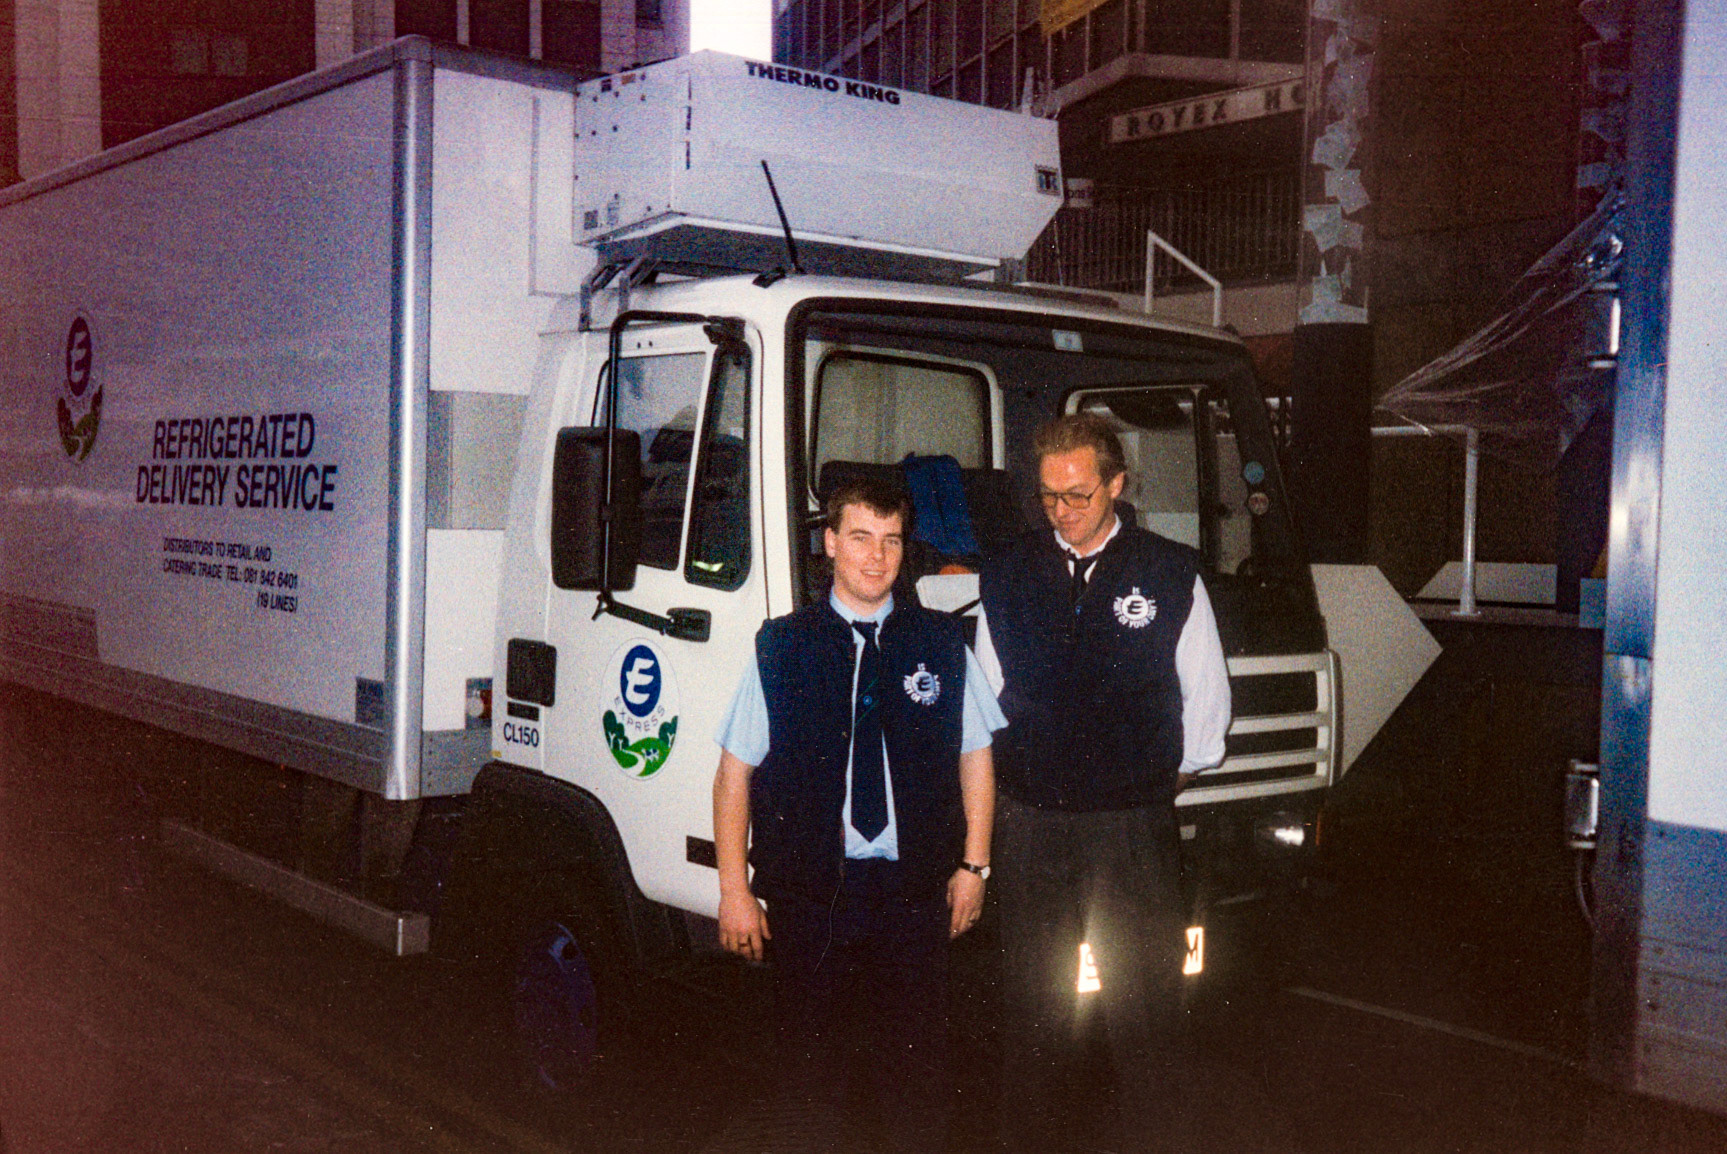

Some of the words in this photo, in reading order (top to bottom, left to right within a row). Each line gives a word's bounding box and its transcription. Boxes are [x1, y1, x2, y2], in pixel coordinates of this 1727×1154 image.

[745, 60, 839, 93] THERMO
[845, 80, 900, 105] KING
[1127, 97, 1228, 138] ROYEX
[153, 413, 315, 459] REFRIGERATED
[137, 464, 229, 506] DELIVERY
[234, 463, 337, 511] SERVICE
[163, 537, 213, 557] DISTRIBUTORS
[216, 541, 226, 558] TO
[227, 543, 252, 561] RETAIL
[253, 545, 273, 562] AND
[163, 558, 197, 577] CATERING
[198, 561, 222, 579] TRADE
[503, 721, 540, 748] CL150
